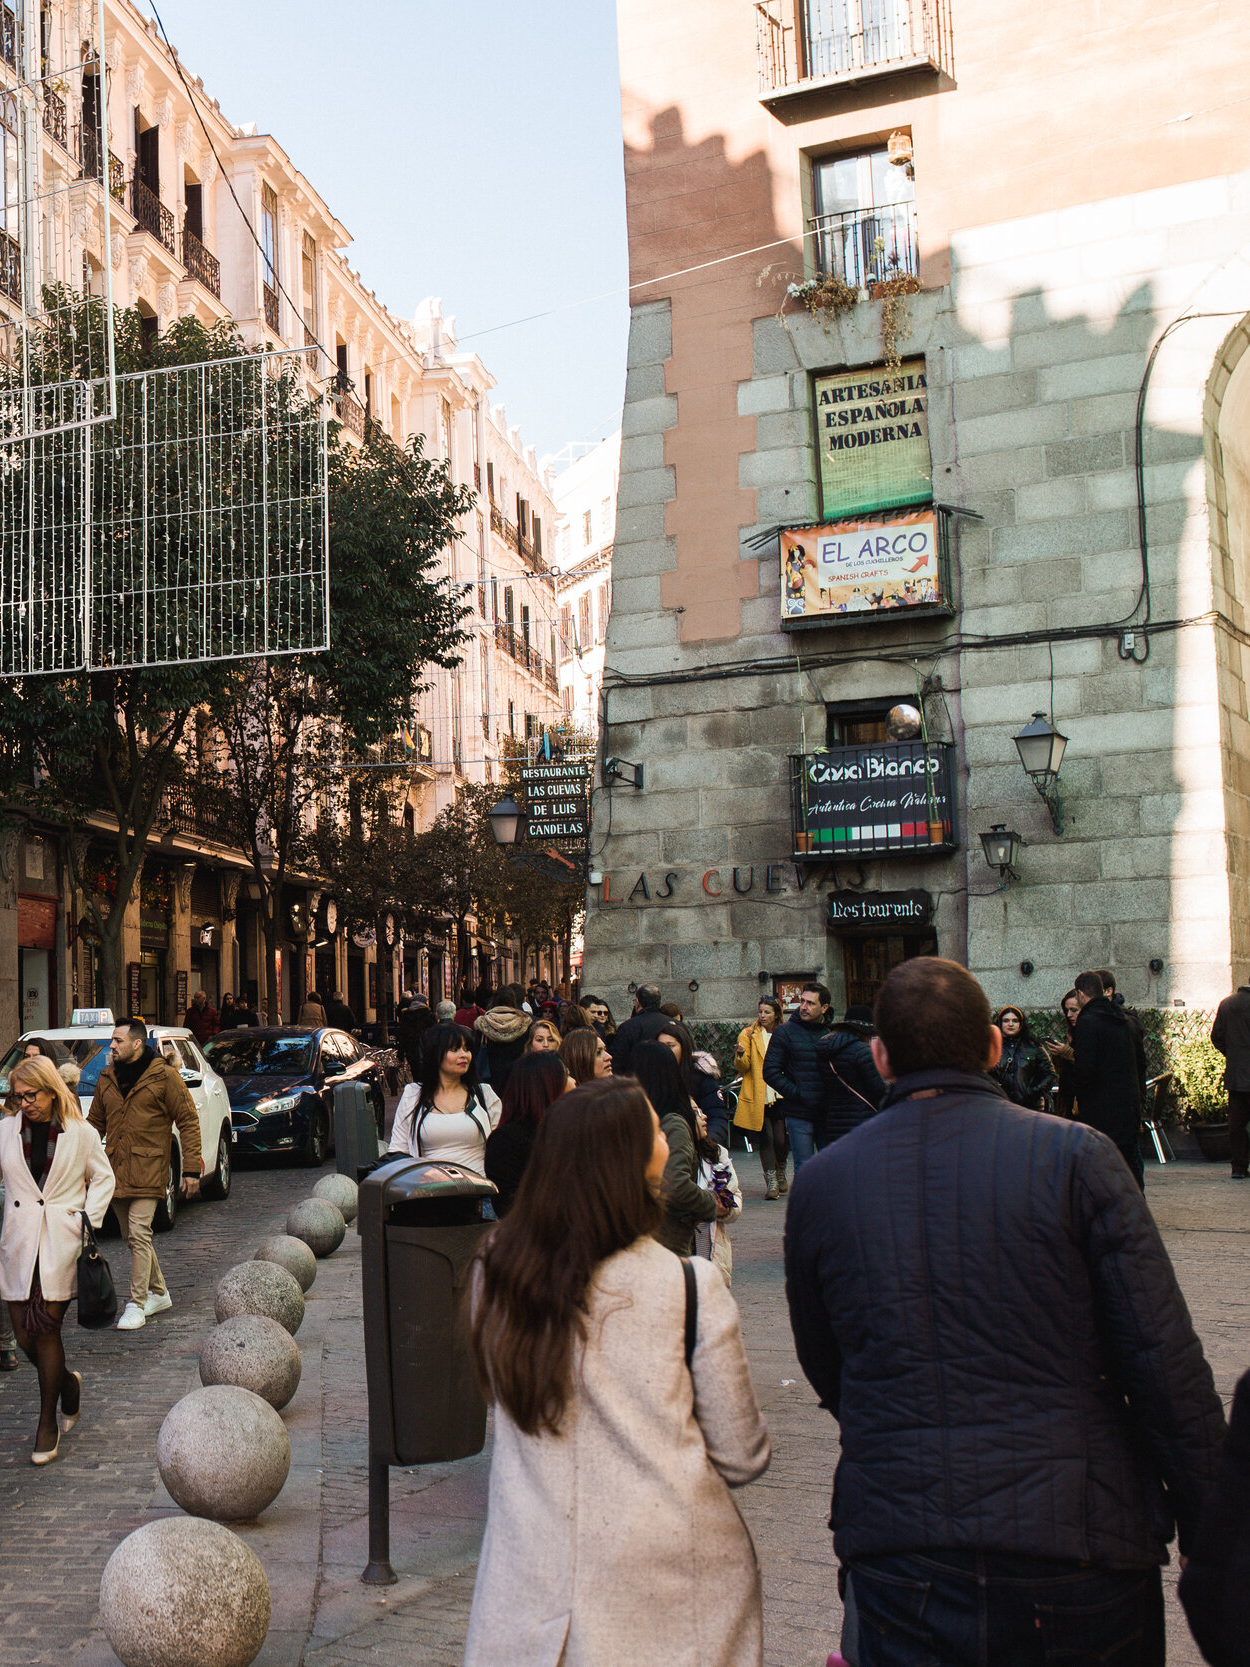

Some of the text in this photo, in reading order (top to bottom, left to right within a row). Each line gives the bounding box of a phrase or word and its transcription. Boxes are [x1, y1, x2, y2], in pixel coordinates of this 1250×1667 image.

[818, 374, 928, 407] ARTESANIA
[825, 397, 925, 428] ESPAÑOLA
[829, 421, 923, 451] MODERNA
[822, 532, 928, 564] EL ARCO
[865, 556, 904, 565] CUCHILLEROS
[827, 569, 889, 583] SPANISH CRAFTS
[522, 766, 586, 779] RESTAURANTE
[809, 757, 940, 783] Casa Bianco
[528, 783, 581, 797] LAS CUEVAS
[533, 803, 577, 816] DE LUIS
[859, 795, 897, 812] Cocina
[529, 822, 584, 836] CANDELAS
[603, 861, 867, 902] LAS CUEVAS
[80, 1011, 108, 1024] TAXI P
